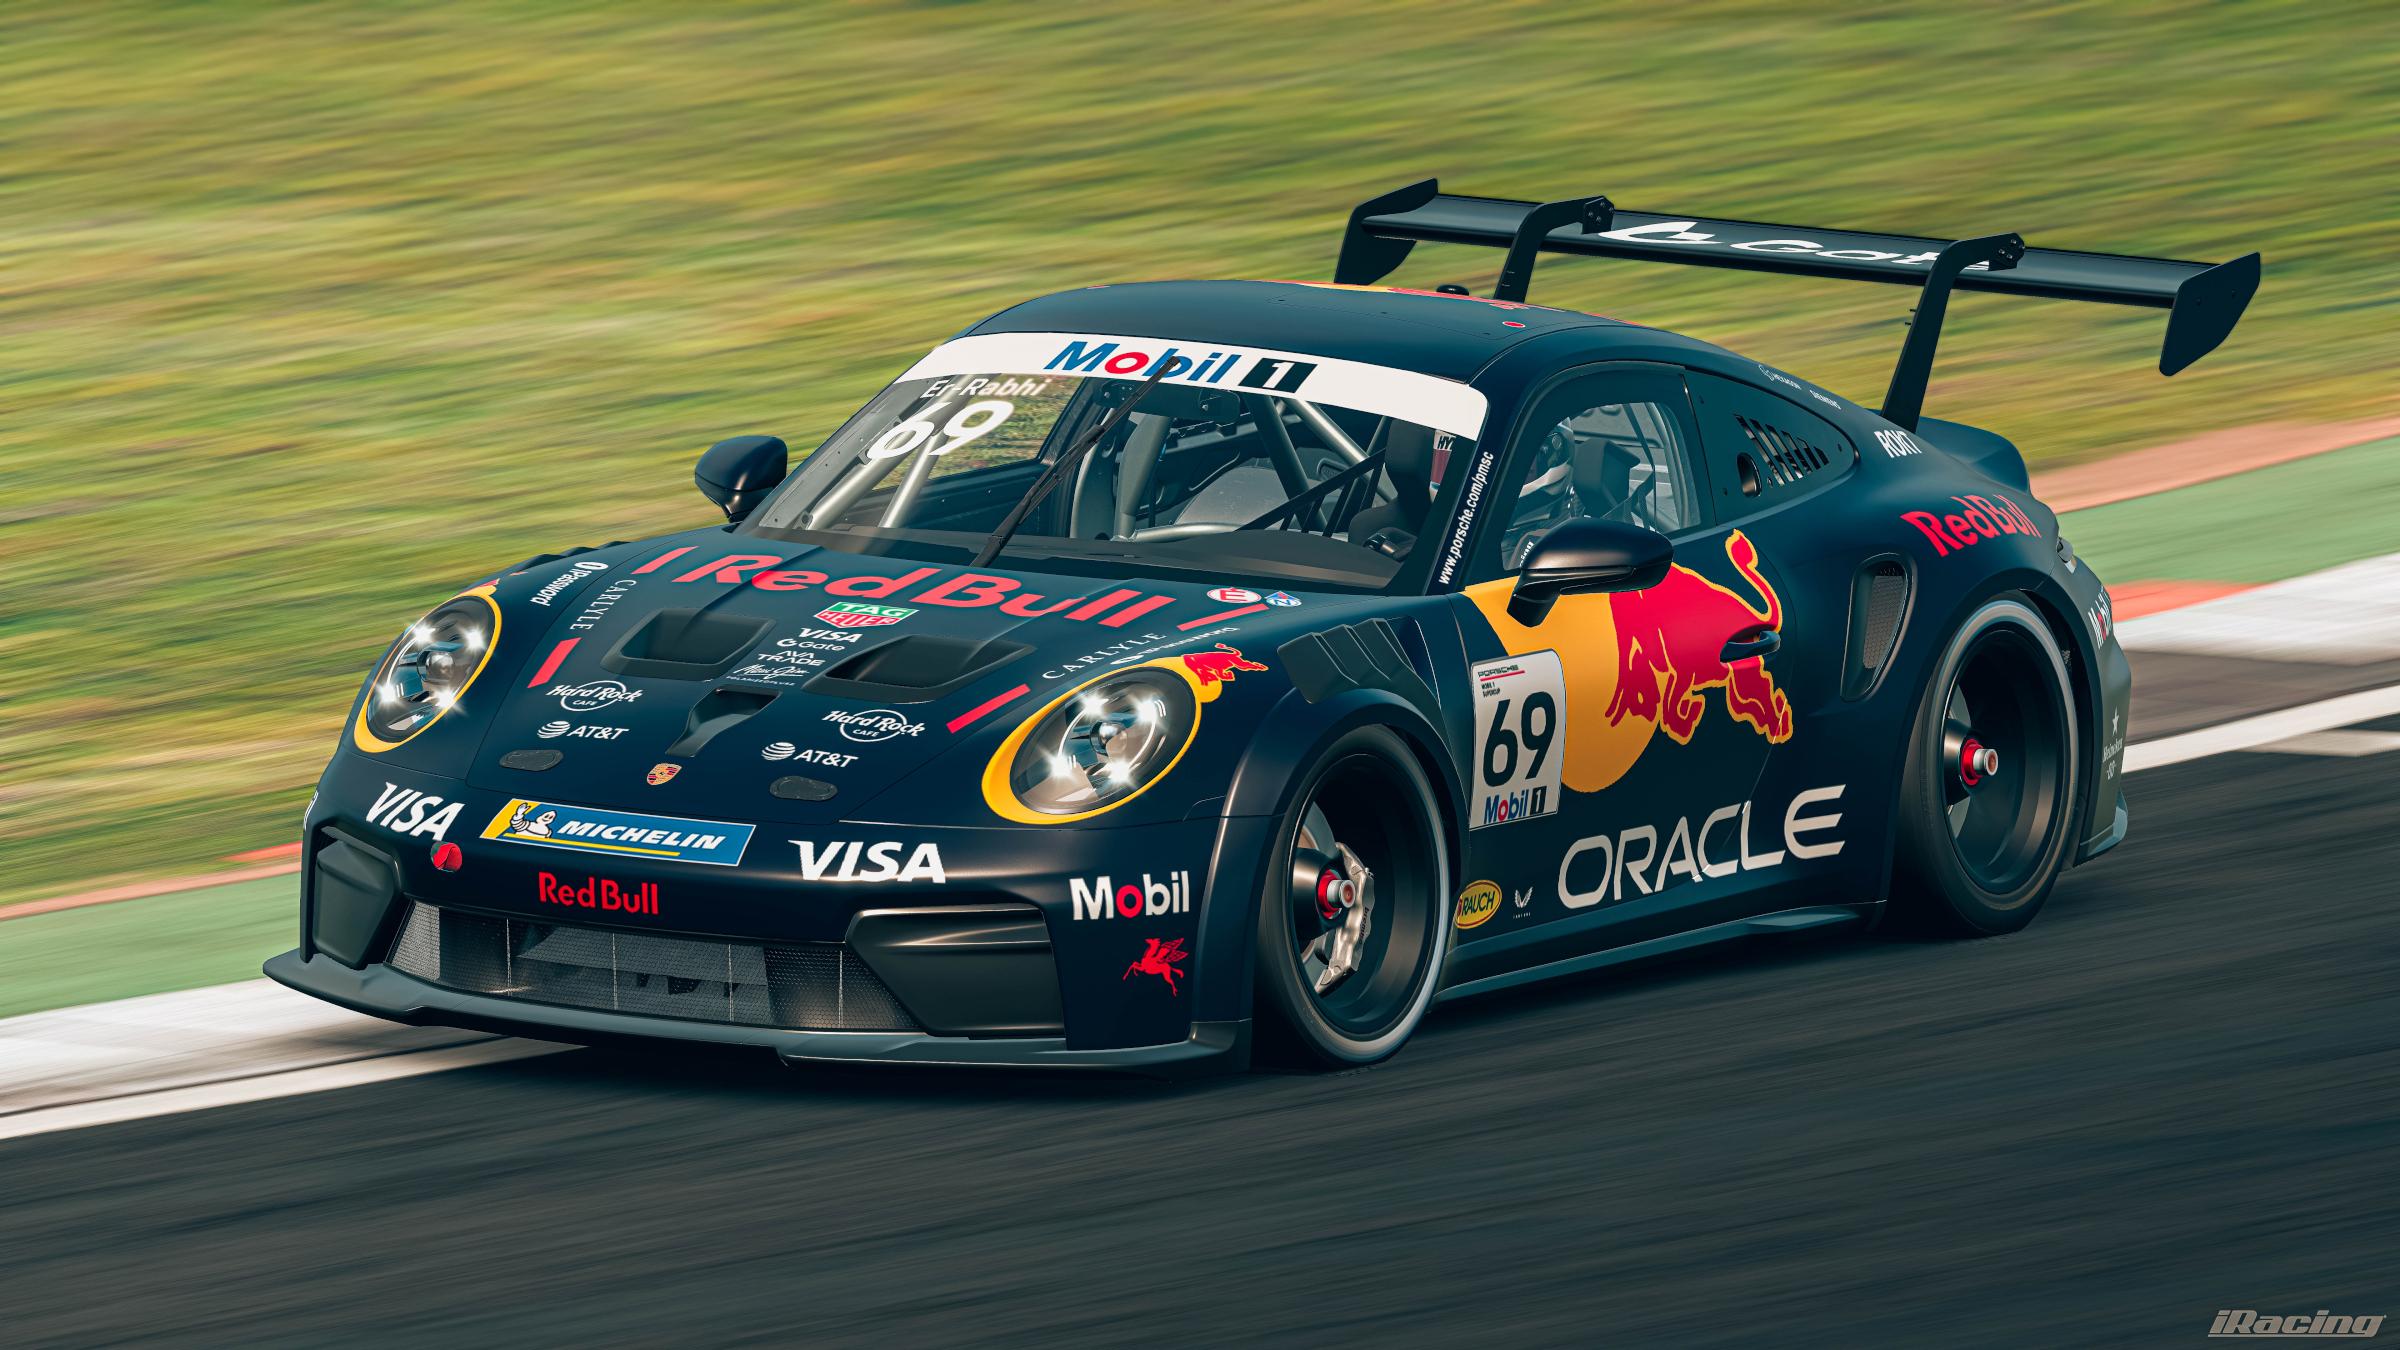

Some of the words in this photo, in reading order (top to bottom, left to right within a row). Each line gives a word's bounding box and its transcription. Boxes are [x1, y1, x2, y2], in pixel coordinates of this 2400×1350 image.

[1044, 340, 1242, 383] Mobil
[920, 378, 1052, 399] Er-Rabhi
[867, 400, 1014, 459] 69
[1438, 451, 1495, 585] www.porsche.com/pmsc
[530, 568, 593, 607] 1Password
[569, 579, 637, 630] CARLYLE
[819, 611, 898, 627] HEUER
[842, 602, 909, 617] TAG
[798, 627, 864, 643] VISA
[798, 641, 846, 651] Gate
[757, 653, 827, 667] TRADE
[777, 650, 815, 659] AVA
[1042, 632, 1168, 680] CARLYLE
[545, 684, 602, 697] Hard
[594, 687, 644, 702] Rock
[566, 725, 630, 740] AT&T
[821, 710, 881, 727] Hard
[874, 717, 926, 737] Rock
[852, 729, 880, 737] CAFE
[1483, 691, 1557, 788] 69
[793, 749, 860, 768] AT&T
[365, 782, 467, 842] VISA
[1484, 789, 1530, 825] Mobil
[556, 819, 727, 852] MICHELIN
[1557, 784, 1847, 910] ORACLE
[788, 839, 947, 884] VISA
[1069, 870, 1191, 921] Mobil
[1461, 890, 1496, 917] RAUCH
